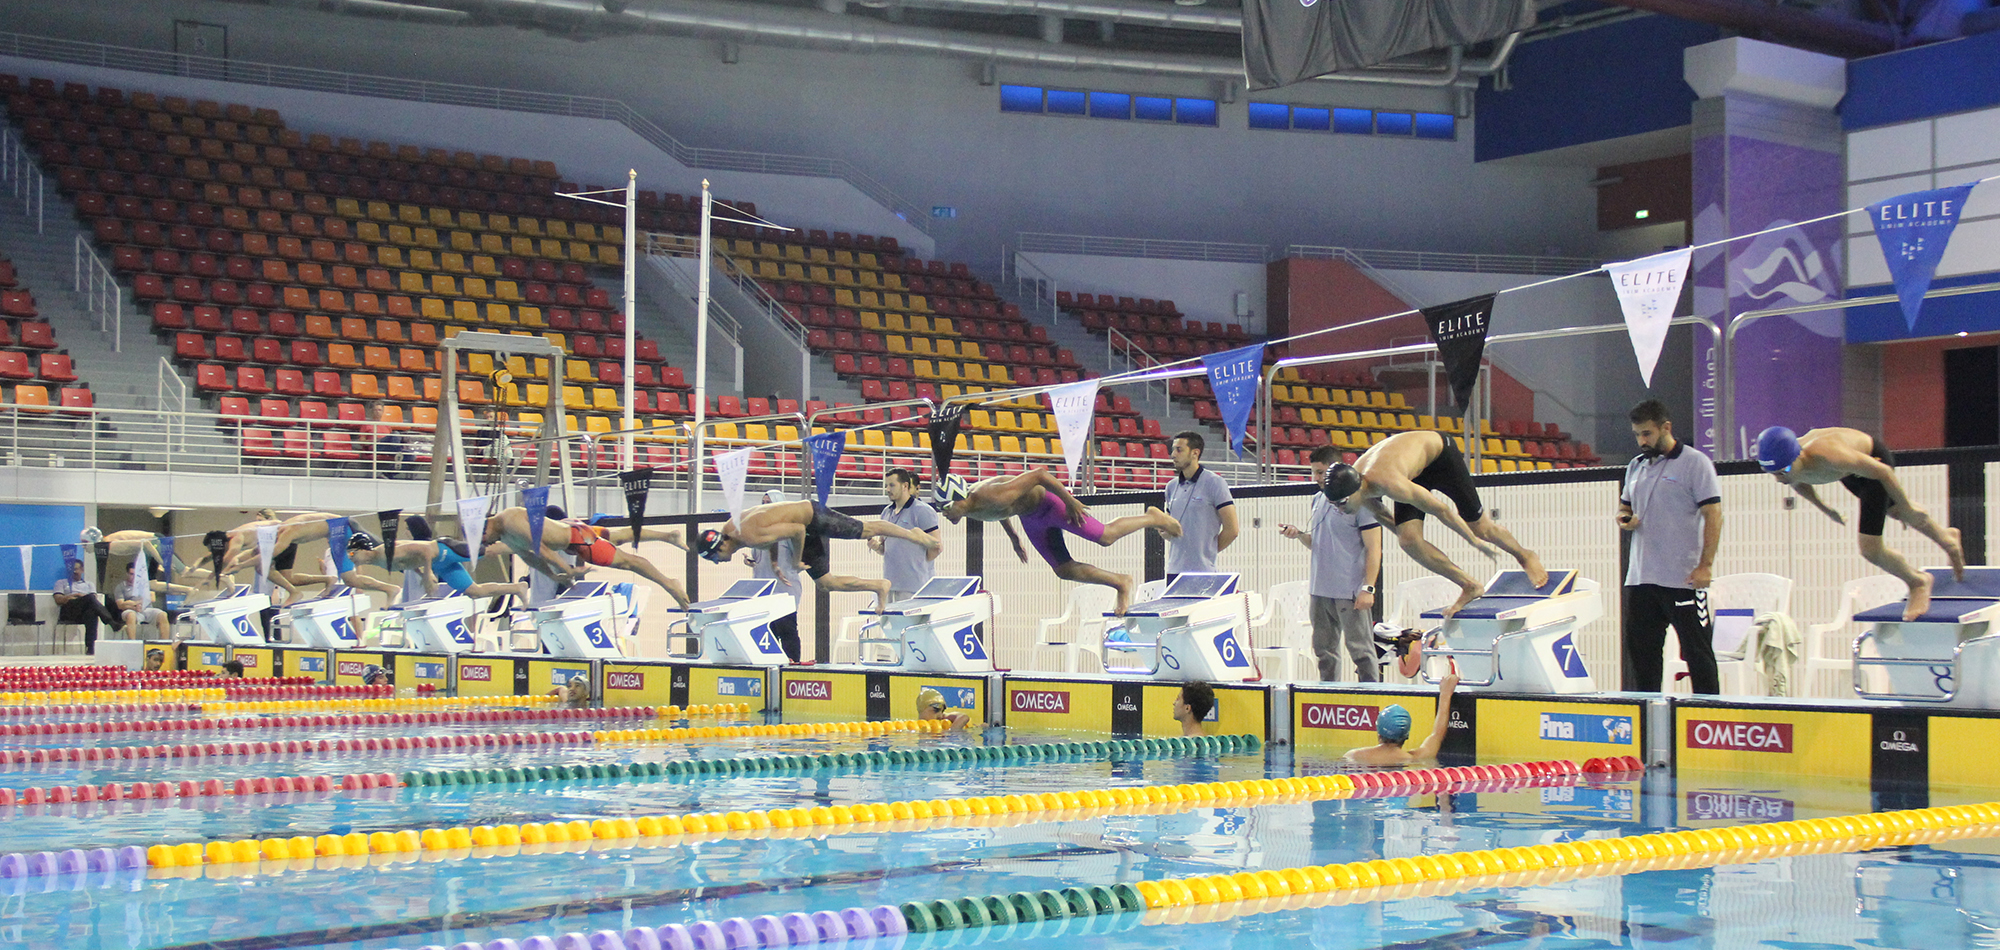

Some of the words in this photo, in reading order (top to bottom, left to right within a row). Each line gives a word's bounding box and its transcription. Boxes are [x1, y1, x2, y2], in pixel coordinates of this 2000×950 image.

[1881, 200, 1953, 220] ELITE
[1621, 269, 1676, 287] ELITE
[1438, 312, 1485, 334] ELITE
[1456, 327, 1485, 338] ACADEMY
[1214, 360, 1254, 380] ELITE
[1056, 395, 1088, 407] ELITE
[811, 439, 838, 452] LITE
[722, 456, 745, 472] ELITE
[624, 479, 648, 491] ELITE
[239, 620, 249, 634] 0
[340, 623, 347, 637] 1
[455, 625, 465, 640] 2
[592, 627, 603, 645] 3
[549, 632, 565, 650] 3
[714, 637, 728, 656] 4
[759, 631, 771, 650] 4
[963, 634, 975, 655] 5
[1222, 637, 1236, 662] 6
[907, 641, 927, 663] 5
[1161, 646, 1180, 670] 6
[1562, 644, 1575, 671] 7
[340, 662, 362, 674] OMEGA
[462, 666, 489, 679] OMEGA
[609, 673, 641, 688] OMEGA
[718, 678, 735, 694] Fina
[789, 681, 828, 698] OMEGA
[1015, 692, 1064, 710] OMEGA
[1117, 703, 1137, 712] OMEGA
[1307, 705, 1372, 727] OMEGA
[1447, 720, 1469, 729] MEGA
[1539, 714, 1575, 739] Fina
[1694, 722, 1784, 749] OMEGA
[1880, 740, 1920, 752] OMEGA
